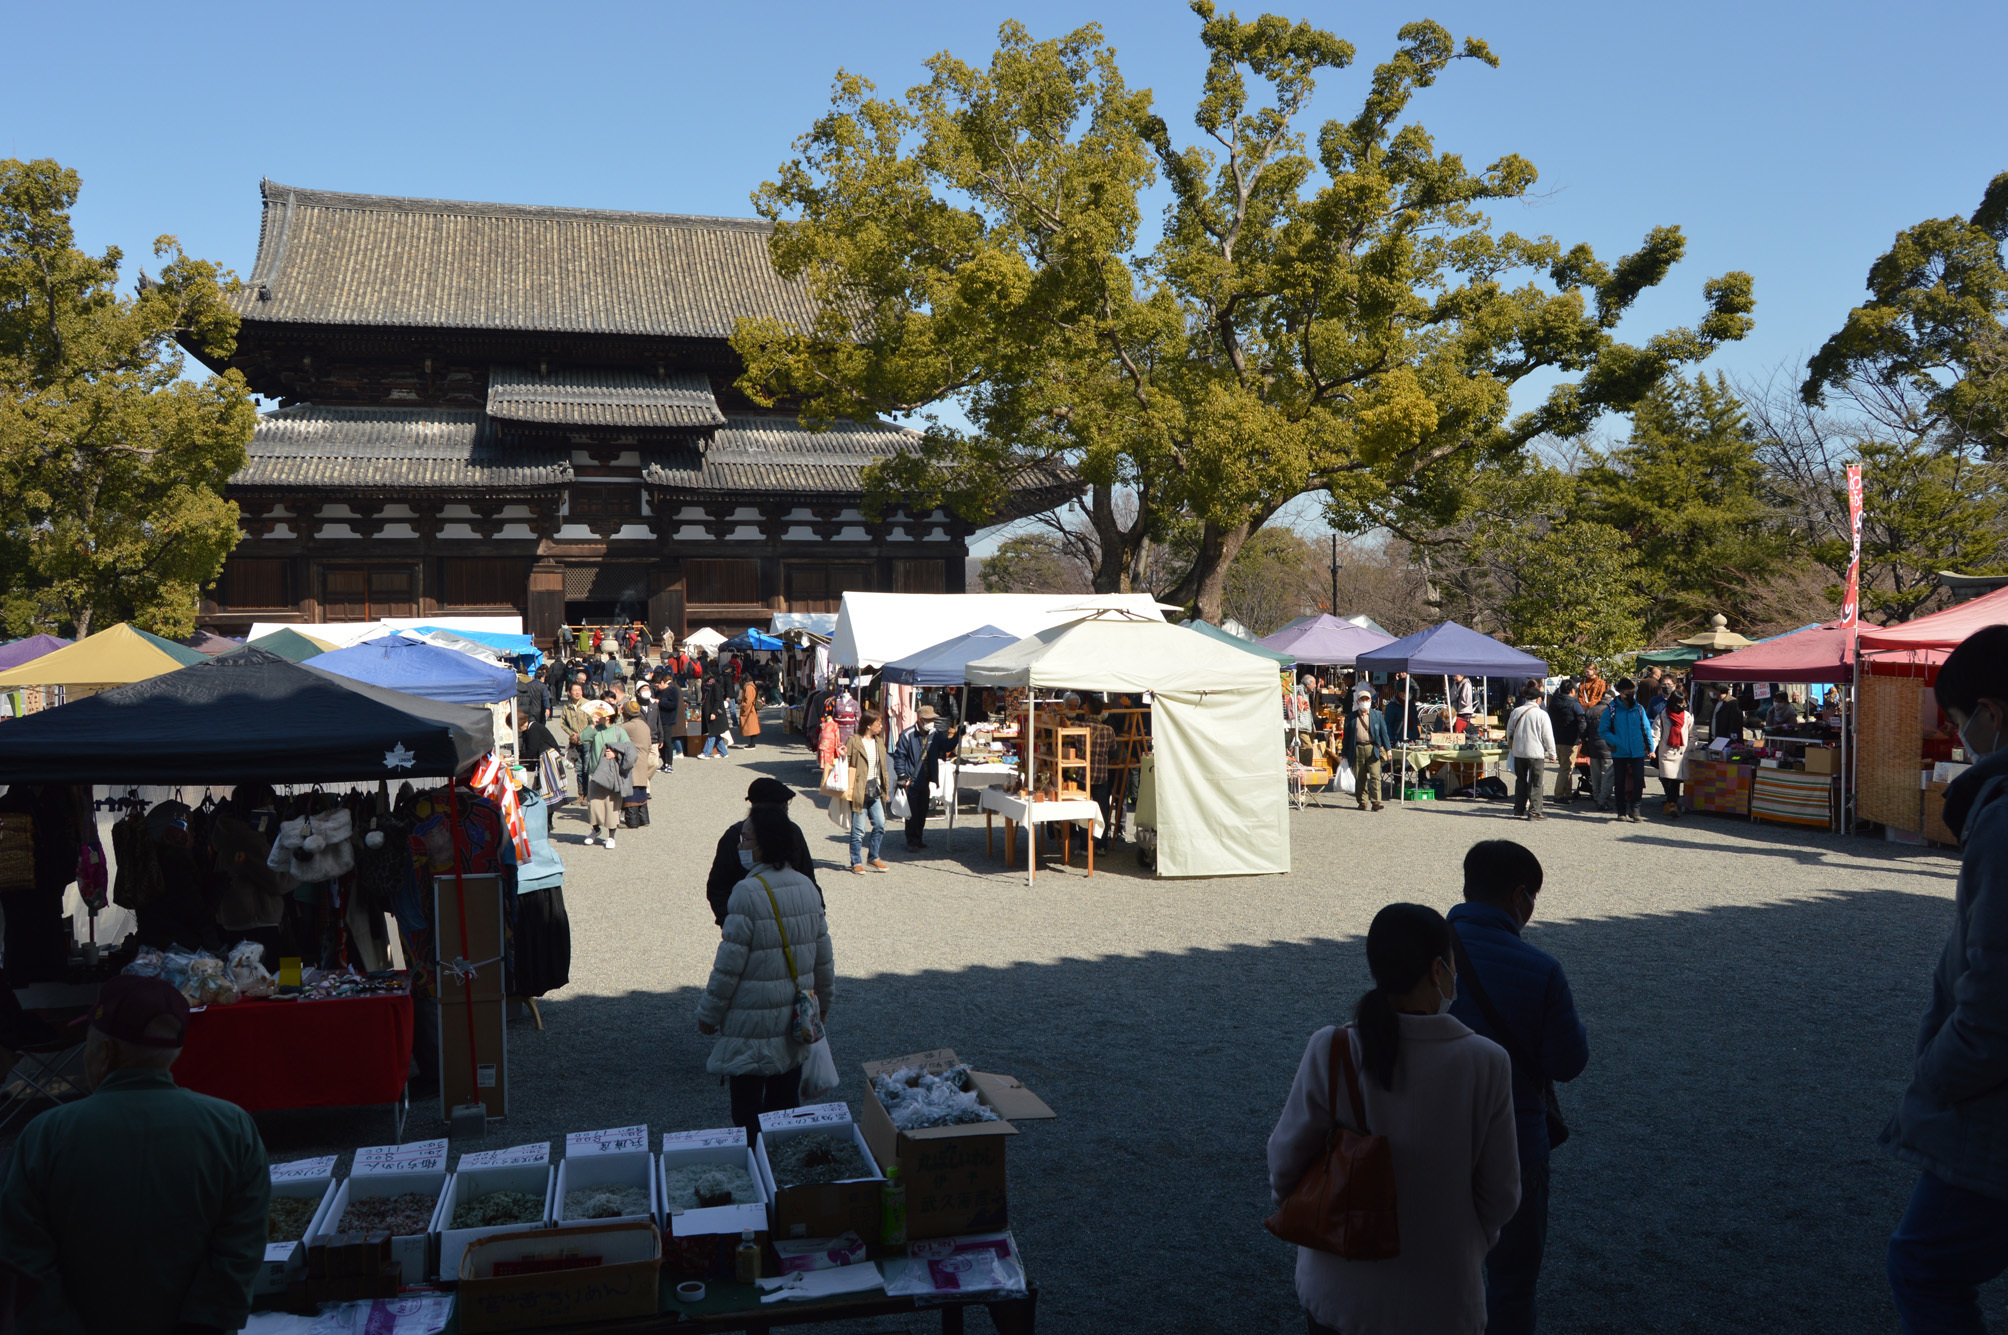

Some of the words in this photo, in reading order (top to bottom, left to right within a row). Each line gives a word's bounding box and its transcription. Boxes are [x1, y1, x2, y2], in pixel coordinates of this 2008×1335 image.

[365, 1146, 400, 1154] 1100
[599, 1137, 645, 1153] 兵庫産
[366, 1153, 394, 1162] 800
[363, 1158, 438, 1172] 梅ちりめん
